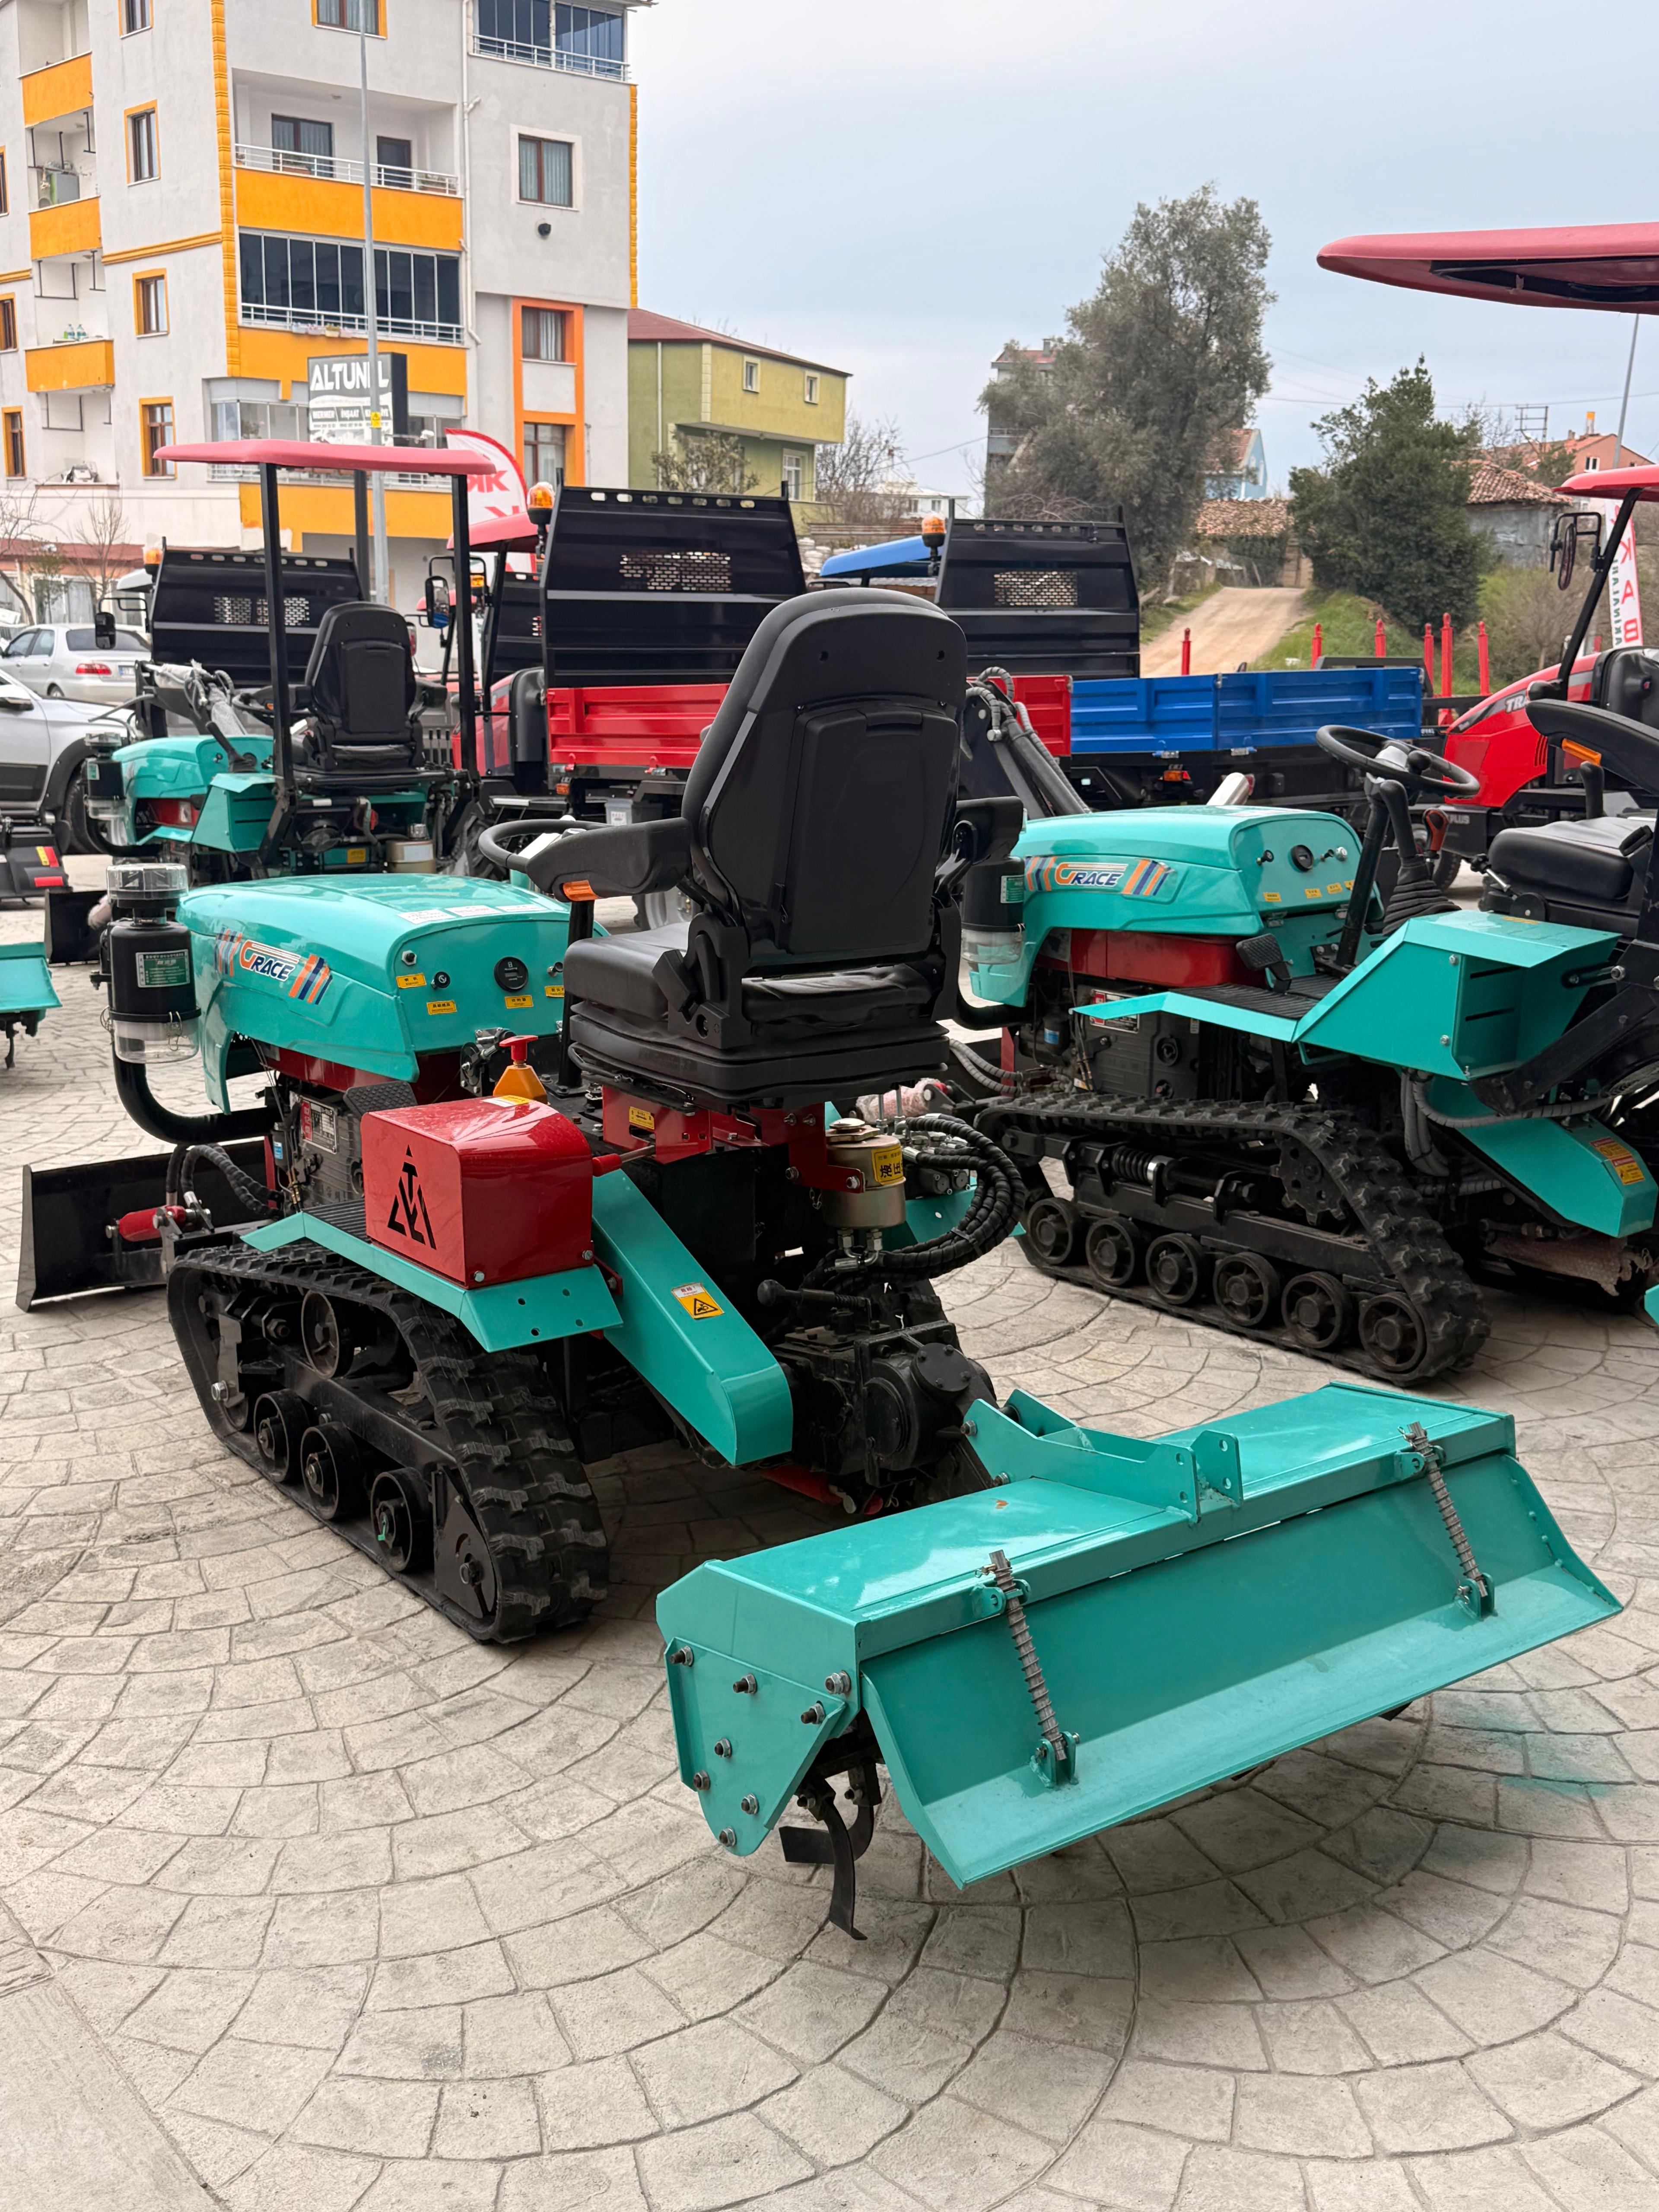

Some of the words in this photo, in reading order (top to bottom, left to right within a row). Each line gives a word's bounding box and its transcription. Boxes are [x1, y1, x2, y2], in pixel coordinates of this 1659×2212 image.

[310, 360, 389, 391] ALTUNL
[1055, 862, 1128, 887] GRACE
[240, 940, 301, 981] GRACE
[880, 1162, 903, 1178] 液压
